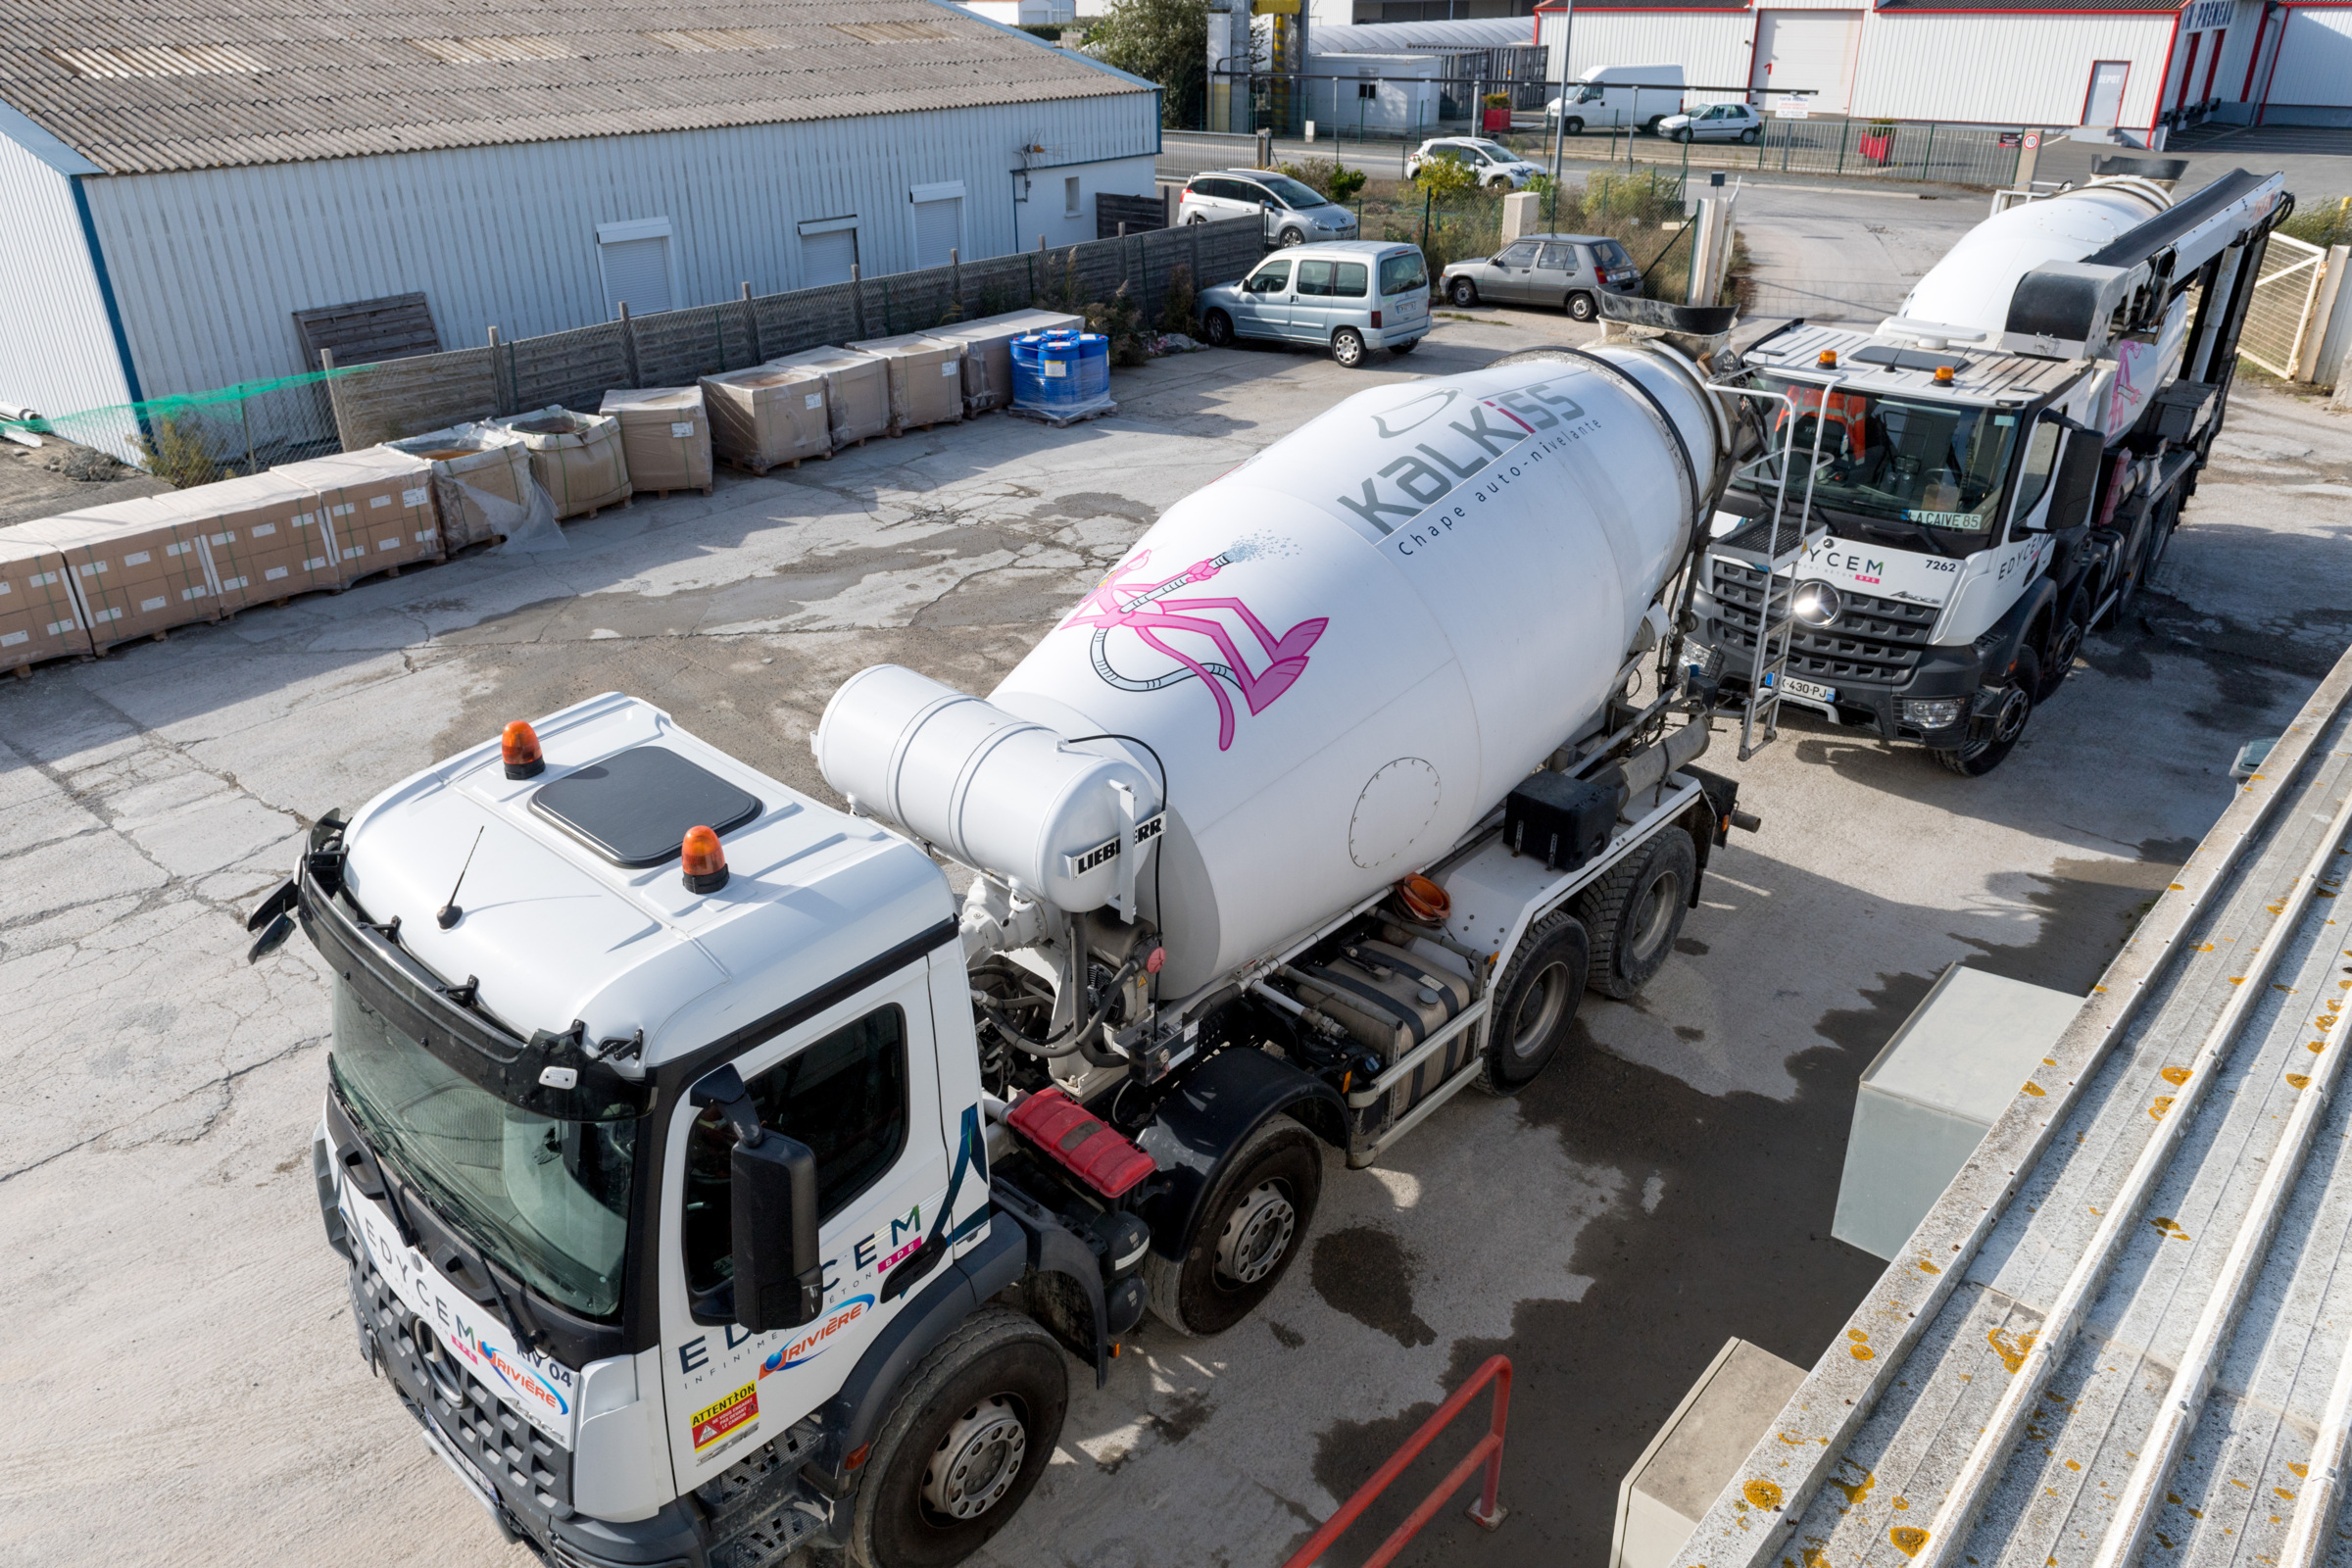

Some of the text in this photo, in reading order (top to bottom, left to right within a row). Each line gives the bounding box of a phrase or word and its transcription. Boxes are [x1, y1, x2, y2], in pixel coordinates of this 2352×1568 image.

[2027, 137, 2035, 147] 10
[1474, 416, 1602, 503] auto-nivelante
[1962, 514, 1979, 528] 85
[1808, 547, 1885, 576] YCEM
[1925, 559, 1957, 573] 7262
[1782, 678, 1828, 698] -430-PJ
[1078, 817, 1162, 875] LIEBRR
[885, 1242, 915, 1267] BPE
[365, 1217, 476, 1351] EDYCEM
[787, 1302, 862, 1361] RIVIÈRE
[496, 1359, 557, 1409] RIVIÈRE
[549, 1362, 572, 1388] 04
